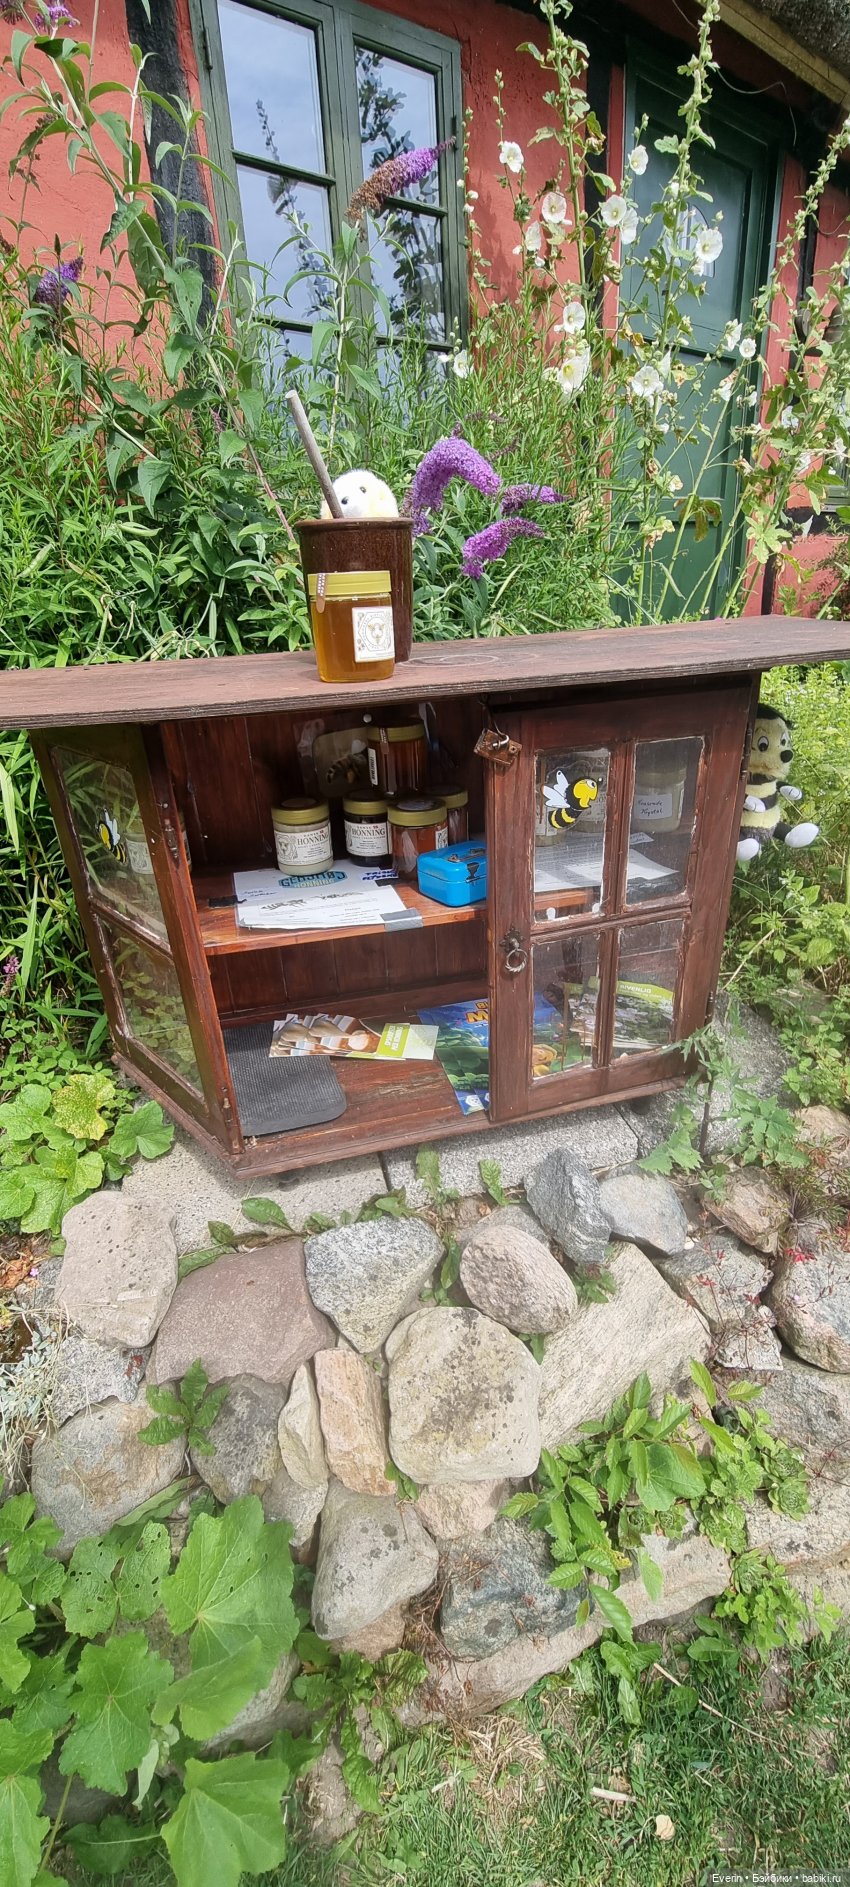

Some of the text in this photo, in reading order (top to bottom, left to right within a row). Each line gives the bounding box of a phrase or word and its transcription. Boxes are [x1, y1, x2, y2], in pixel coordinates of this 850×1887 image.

[351, 828, 386, 837] HONNING
[296, 832, 330, 846] HONNING
[294, 878, 335, 888] HONNING
